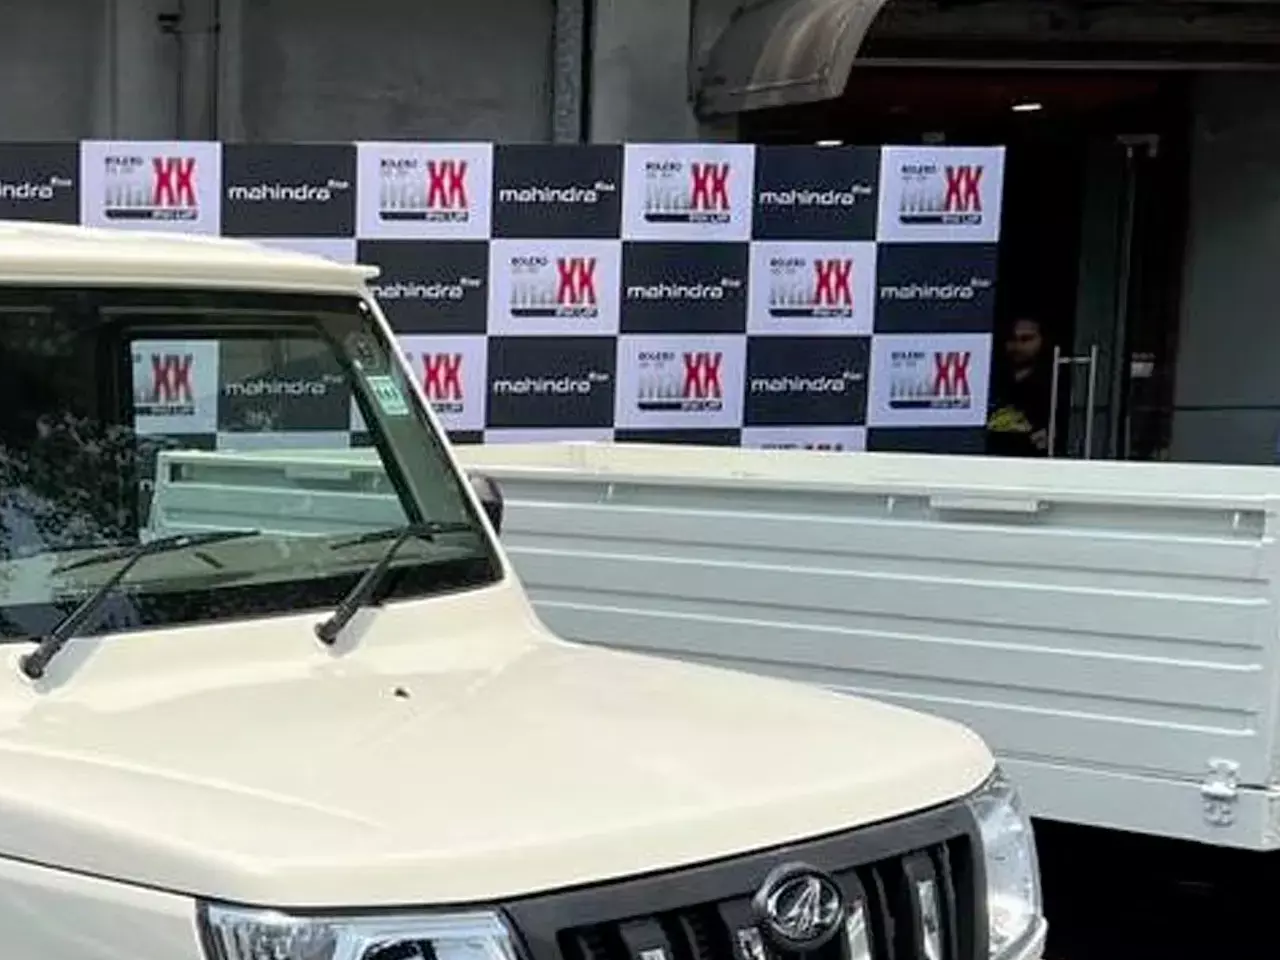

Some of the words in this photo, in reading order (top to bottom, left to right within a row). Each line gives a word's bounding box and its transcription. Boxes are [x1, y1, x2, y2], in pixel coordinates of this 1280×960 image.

[228, 183, 331, 201] mahindra
[499, 186, 598, 203] mahindra
[759, 190, 855, 206] mahindra
[627, 283, 723, 299] mahindra
[880, 282, 975, 299] mahindra
[422, 354, 463, 401] XX
[493, 377, 591, 393] mahindra
[750, 376, 845, 392] mahindra
[224, 379, 326, 396] mahindra
